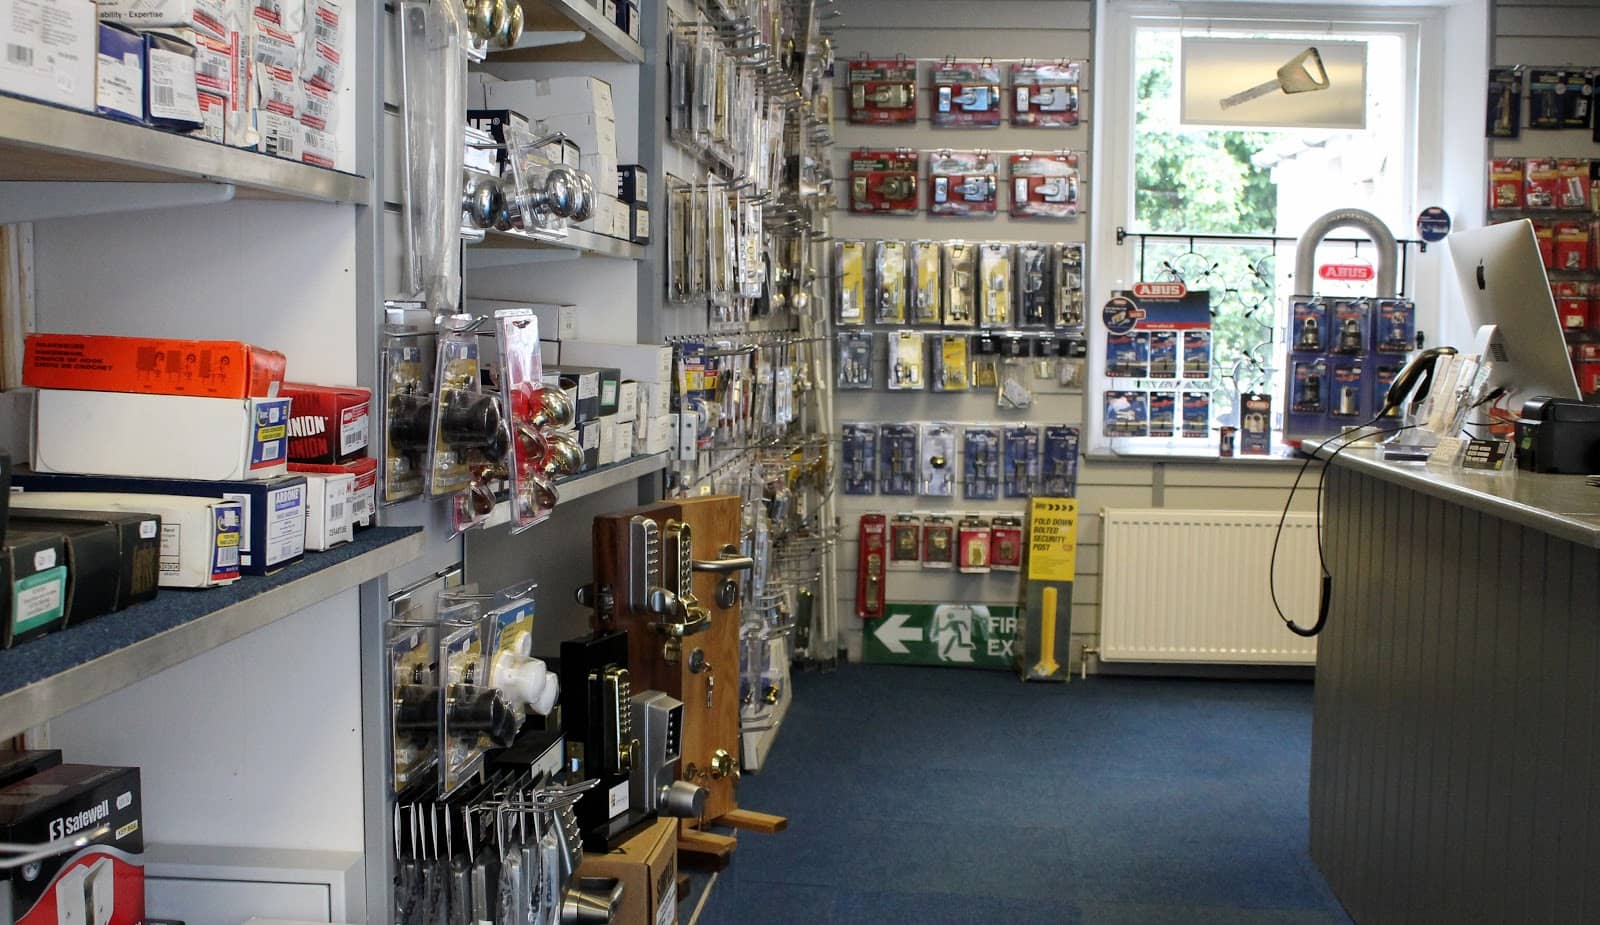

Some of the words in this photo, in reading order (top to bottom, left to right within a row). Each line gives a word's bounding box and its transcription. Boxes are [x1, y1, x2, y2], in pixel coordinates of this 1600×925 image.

[129, 11, 163, 19] Expertise
[1324, 266, 1367, 278] ABUS
[1139, 284, 1180, 295] ABUS
[1034, 518, 1051, 526] FOLD
[1052, 518, 1074, 527] DOWN
[1033, 526, 1059, 535] BOLTED
[1032, 535, 1066, 544] SECURITY
[1032, 543, 1050, 552] POST
[988, 640, 1013, 656] EX
[66, 800, 109, 834] Safewell
